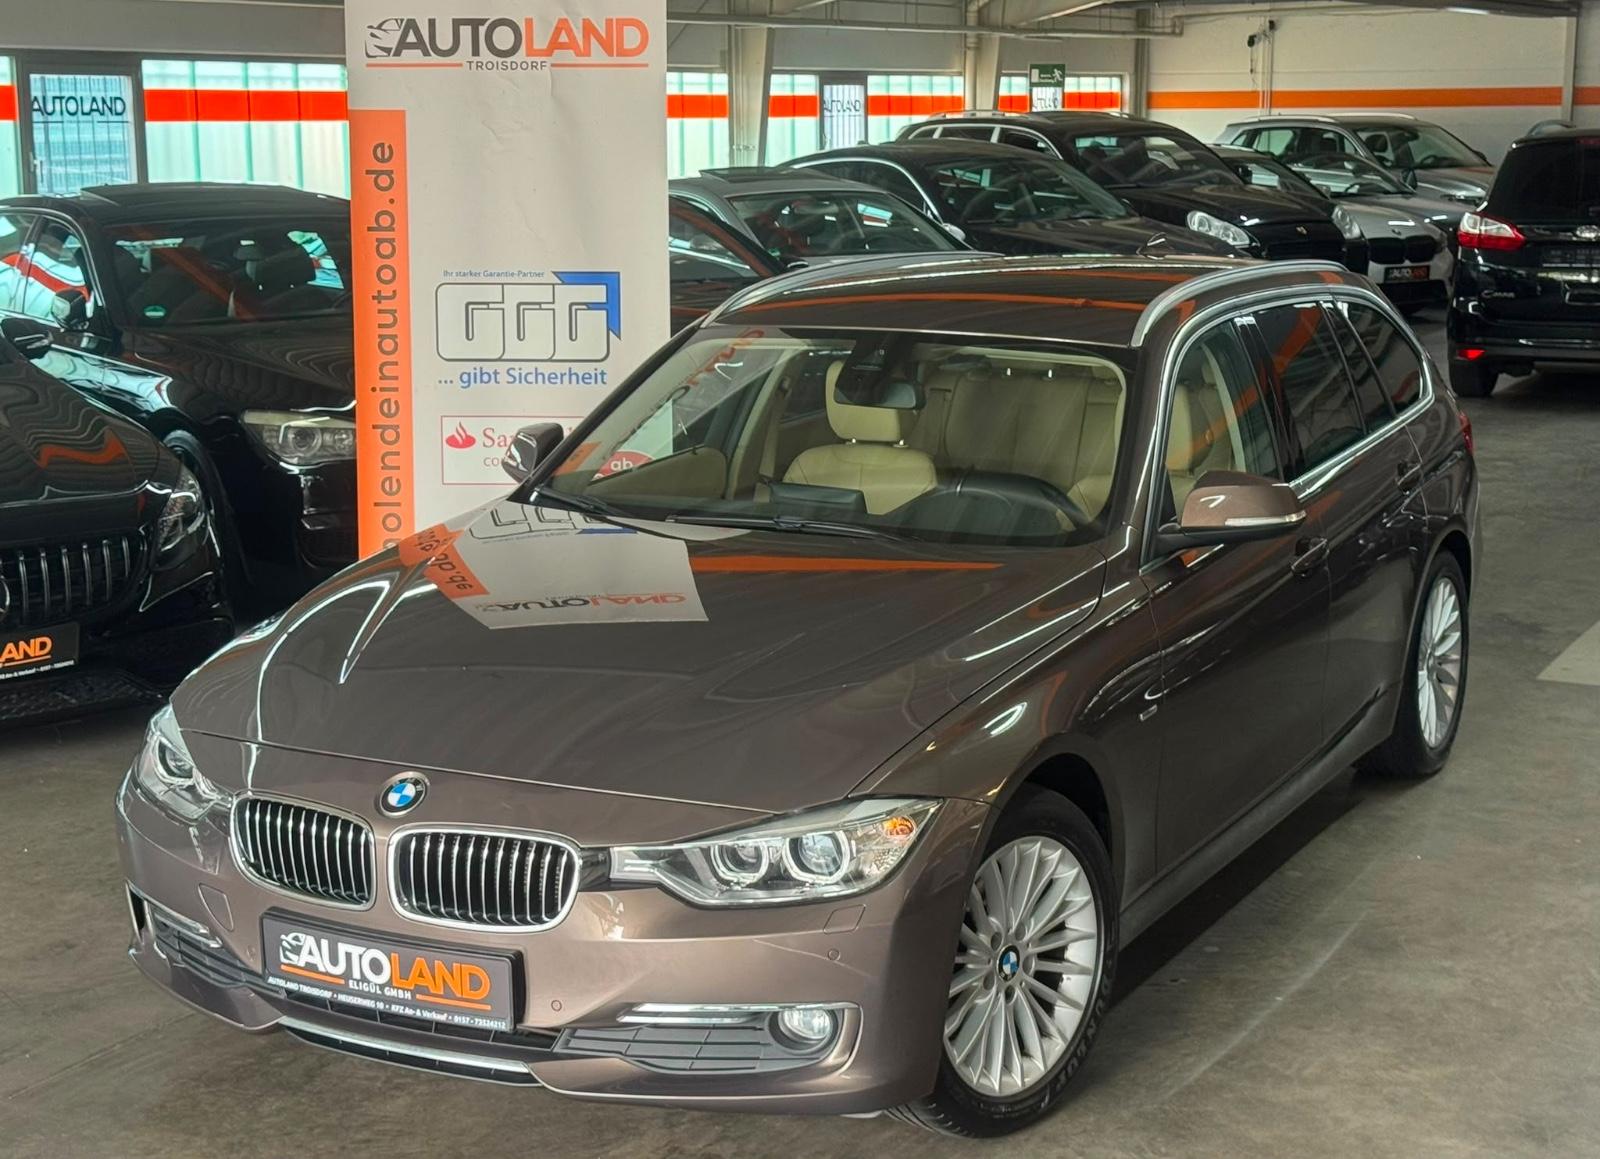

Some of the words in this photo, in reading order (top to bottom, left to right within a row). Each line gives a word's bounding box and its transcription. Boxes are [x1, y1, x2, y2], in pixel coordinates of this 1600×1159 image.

[394, 17, 649, 58] AUTOLAND
[467, 60, 548, 72] TROISDORF
[31, 96, 126, 117] AUTOLAND
[455, 270, 482, 278] starker
[483, 270, 545, 279] Garantie-Partner
[459, 367, 501, 389] gibt
[506, 367, 607, 385] Sicherheit
[0, 636, 53, 663] AND
[297, 935, 492, 1001] AUTOLAND
[267, 976, 299, 992] AUTOLAND
[299, 984, 333, 999] TROISDORF
[348, 979, 382, 995] ELIGÜL
[384, 986, 412, 1001] GMBH
